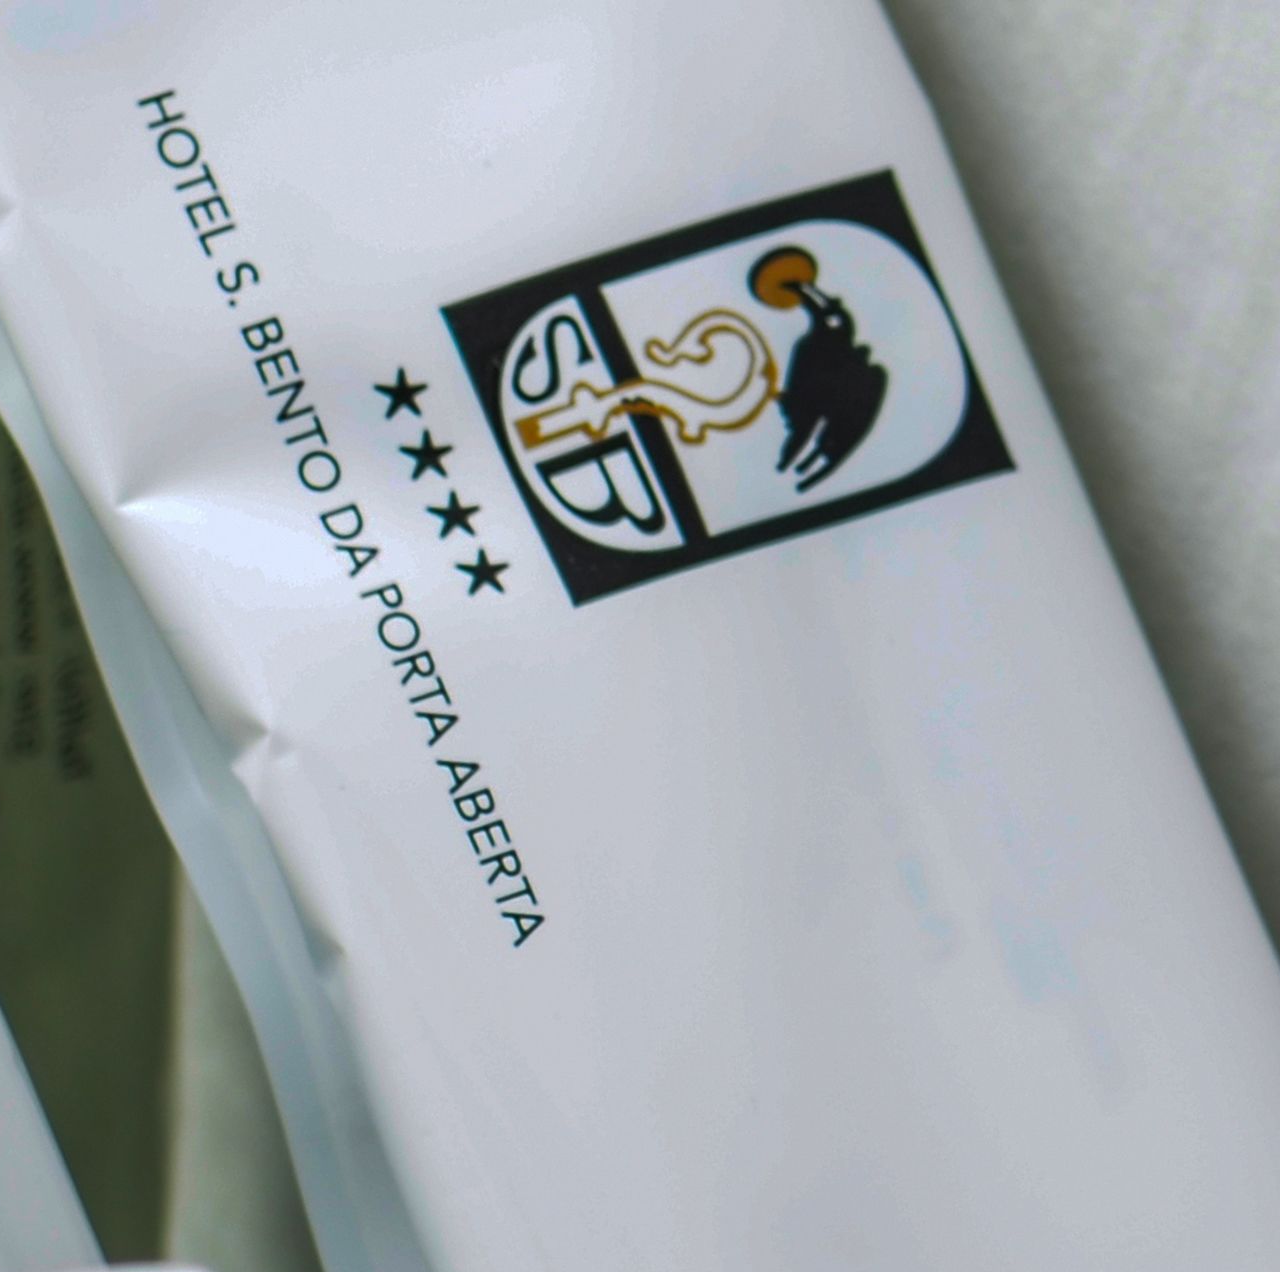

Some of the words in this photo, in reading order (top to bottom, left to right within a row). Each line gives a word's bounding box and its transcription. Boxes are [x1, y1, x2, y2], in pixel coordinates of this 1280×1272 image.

[137, 90, 235, 257] HOTEL
[217, 262, 259, 307] S.
[241, 317, 341, 492] BENTO
[319, 503, 379, 577] DA
[361, 583, 459, 747] PORTA
[436, 760, 545, 947] ABERTA
